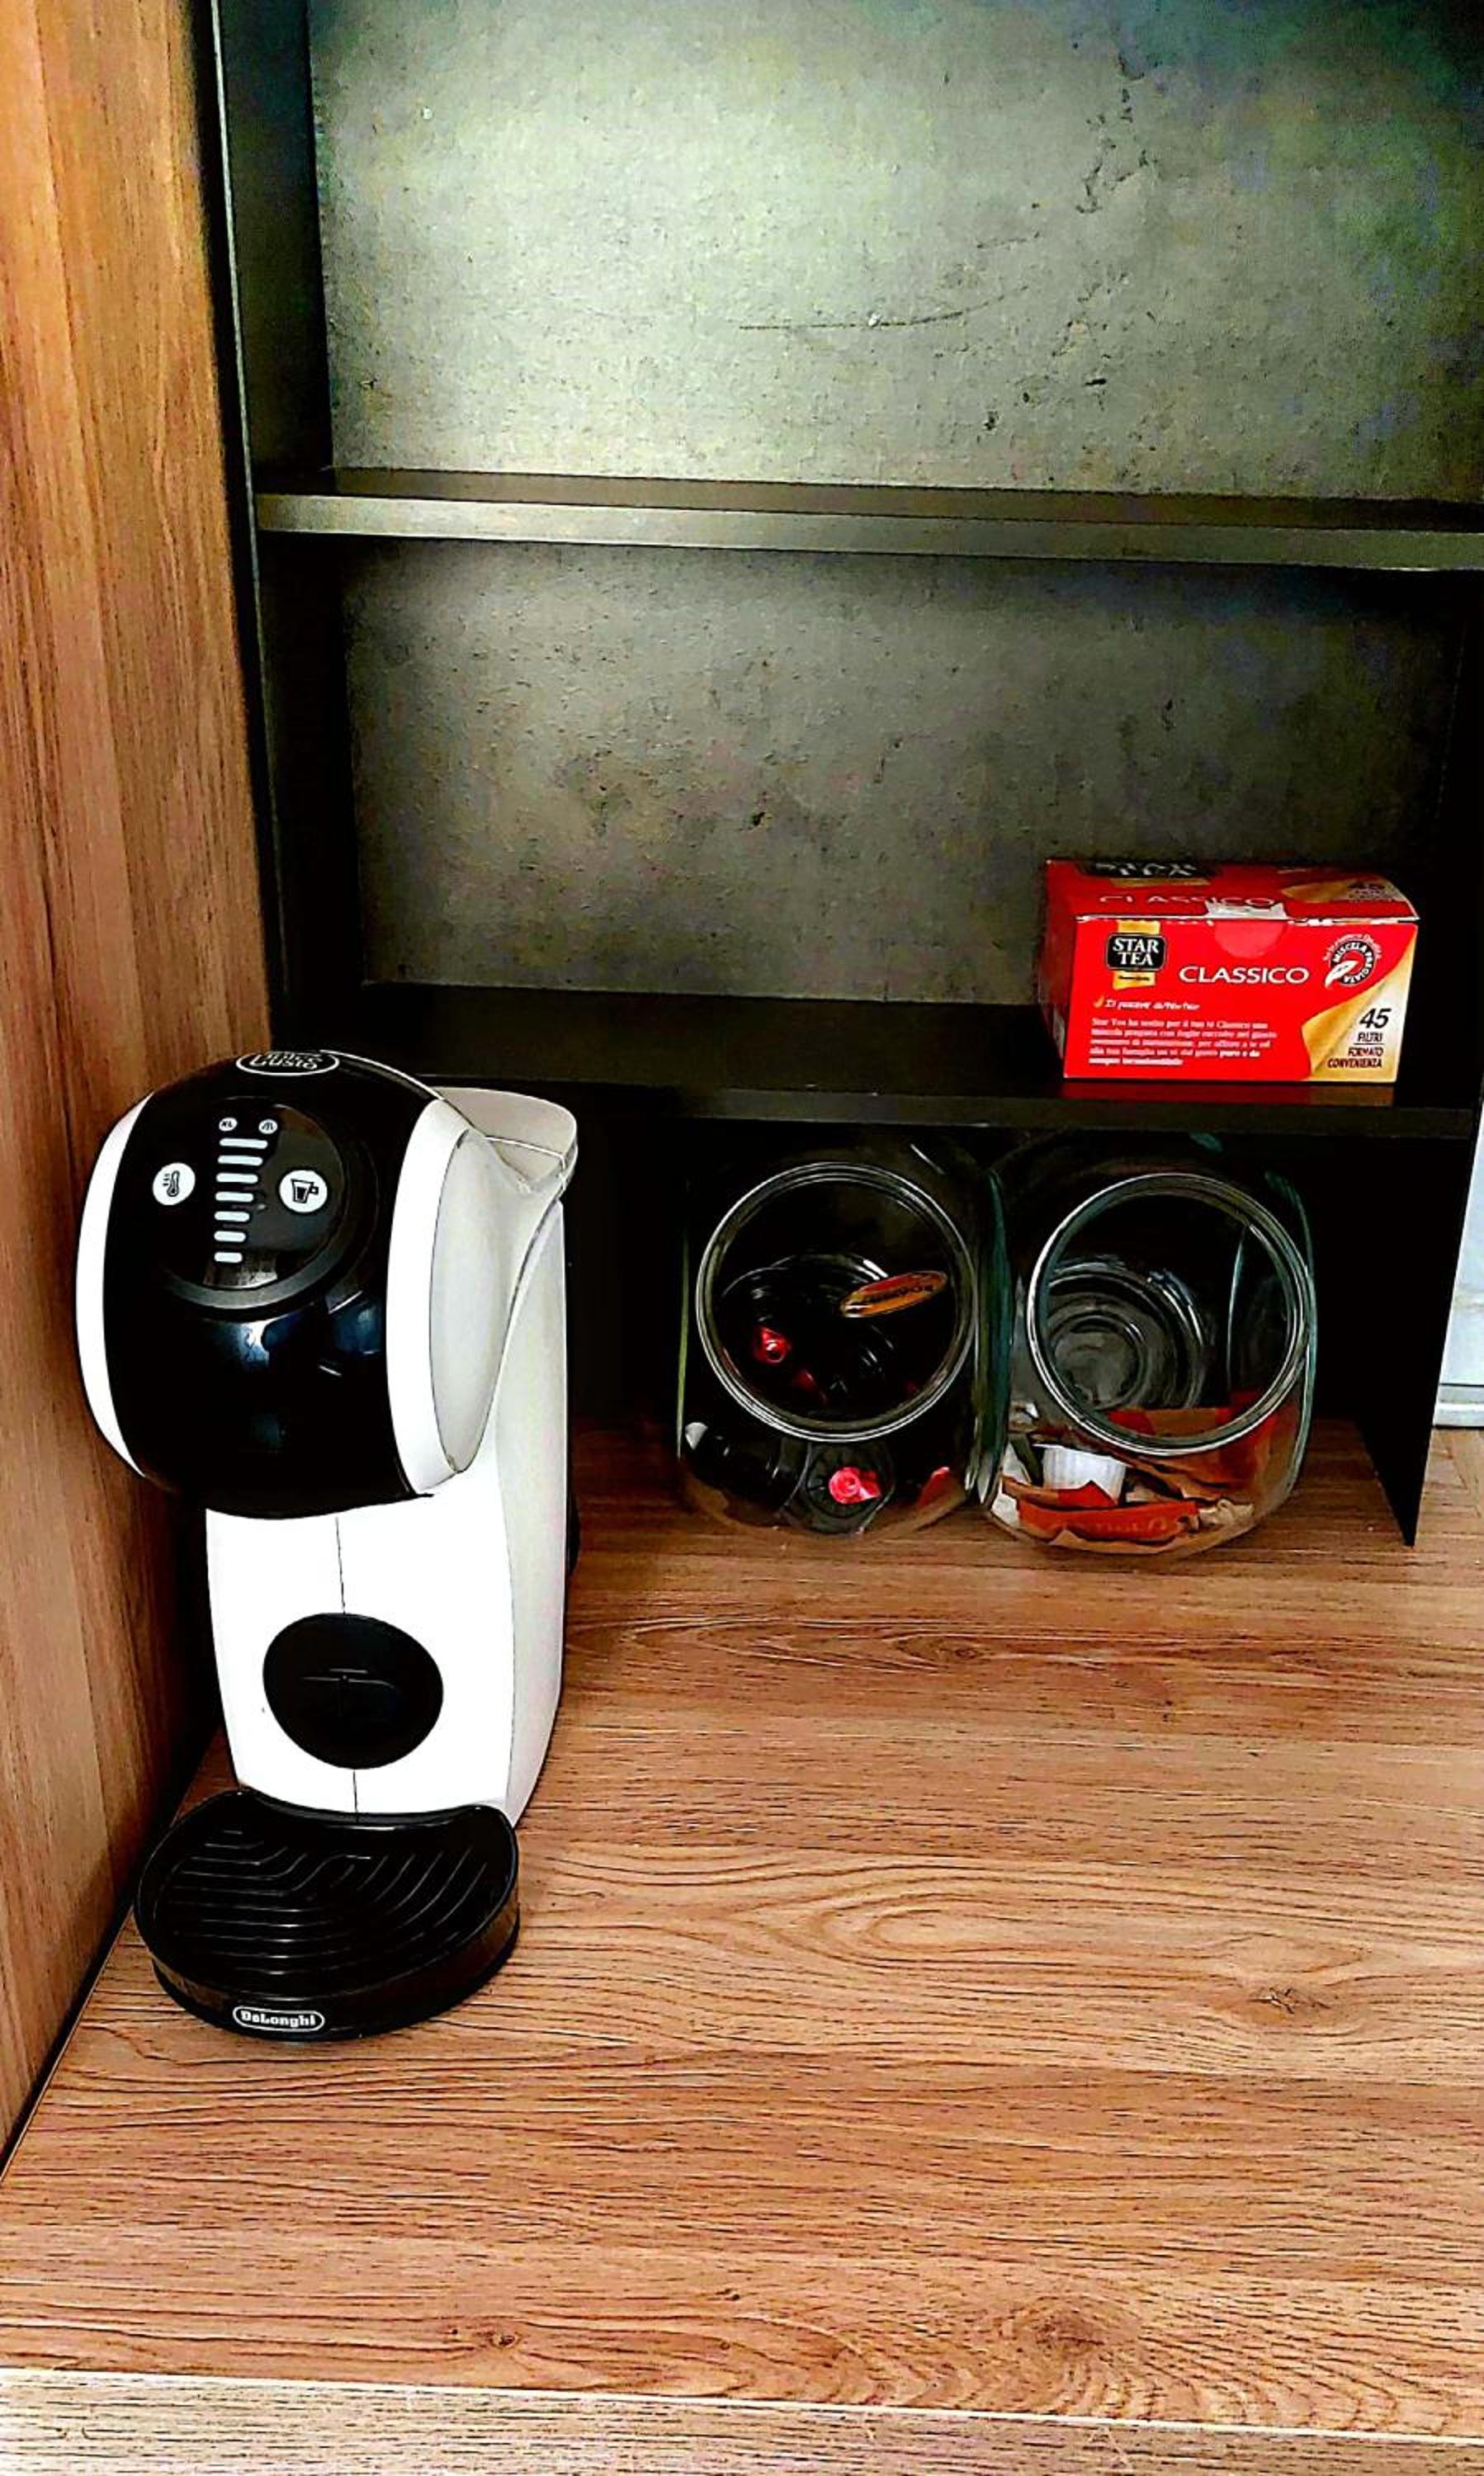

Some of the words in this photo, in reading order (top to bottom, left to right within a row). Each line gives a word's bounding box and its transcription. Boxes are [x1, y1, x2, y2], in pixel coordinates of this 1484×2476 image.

[1113, 938, 1160, 953] STAR
[1117, 952, 1154, 966] TEA
[1179, 966, 1310, 985] CLASSICO
[1359, 1008, 1392, 1029] 45
[1357, 1032, 1384, 1042] FILTRI
[1348, 1047, 1384, 1056] FORMATO
[1327, 1058, 1382, 1068] CONVENIENZA
